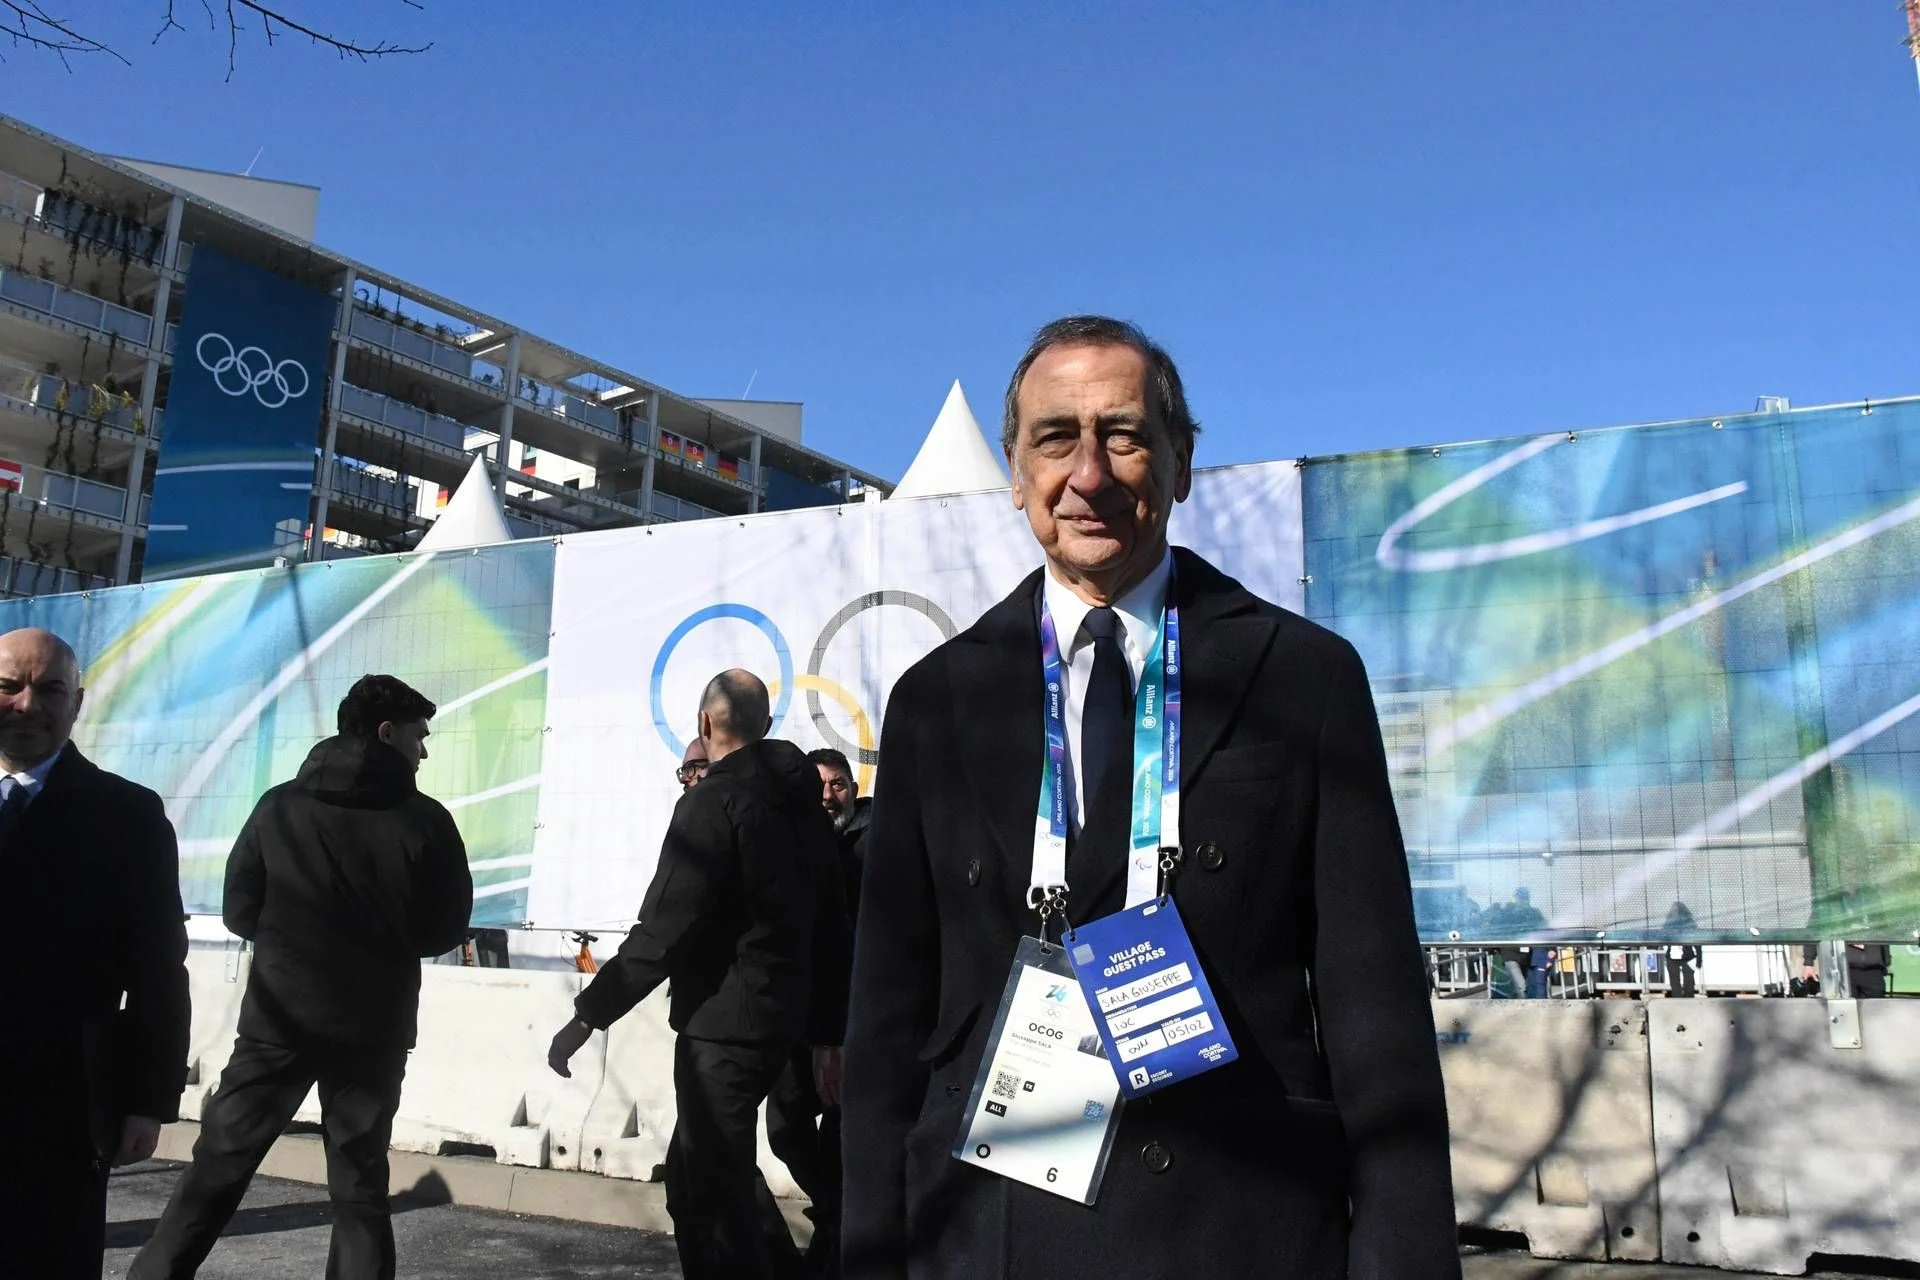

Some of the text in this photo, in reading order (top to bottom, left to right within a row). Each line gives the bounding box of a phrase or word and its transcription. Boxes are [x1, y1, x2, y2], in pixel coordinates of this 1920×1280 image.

[1168, 639, 1176, 664] Allianz
[1051, 692, 1059, 719] Allianz
[1145, 684, 1155, 715] Allianz
[1109, 941, 1152, 964] VILLAGE
[1103, 947, 1166, 977] GUEST PASS
[1101, 972, 1182, 1008] SALA GIUSEPPE
[1028, 1022, 1064, 1040] OCOG
[1114, 1018, 1135, 1031] IOC
[1168, 1020, 1205, 1039] 05/02
[1198, 1043, 1221, 1056] MILANO
[1203, 1047, 1228, 1059] CORTINA
[1134, 1073, 1145, 1085] R
[989, 1104, 1002, 1113] ALL
[1046, 1166, 1059, 1183] 6
